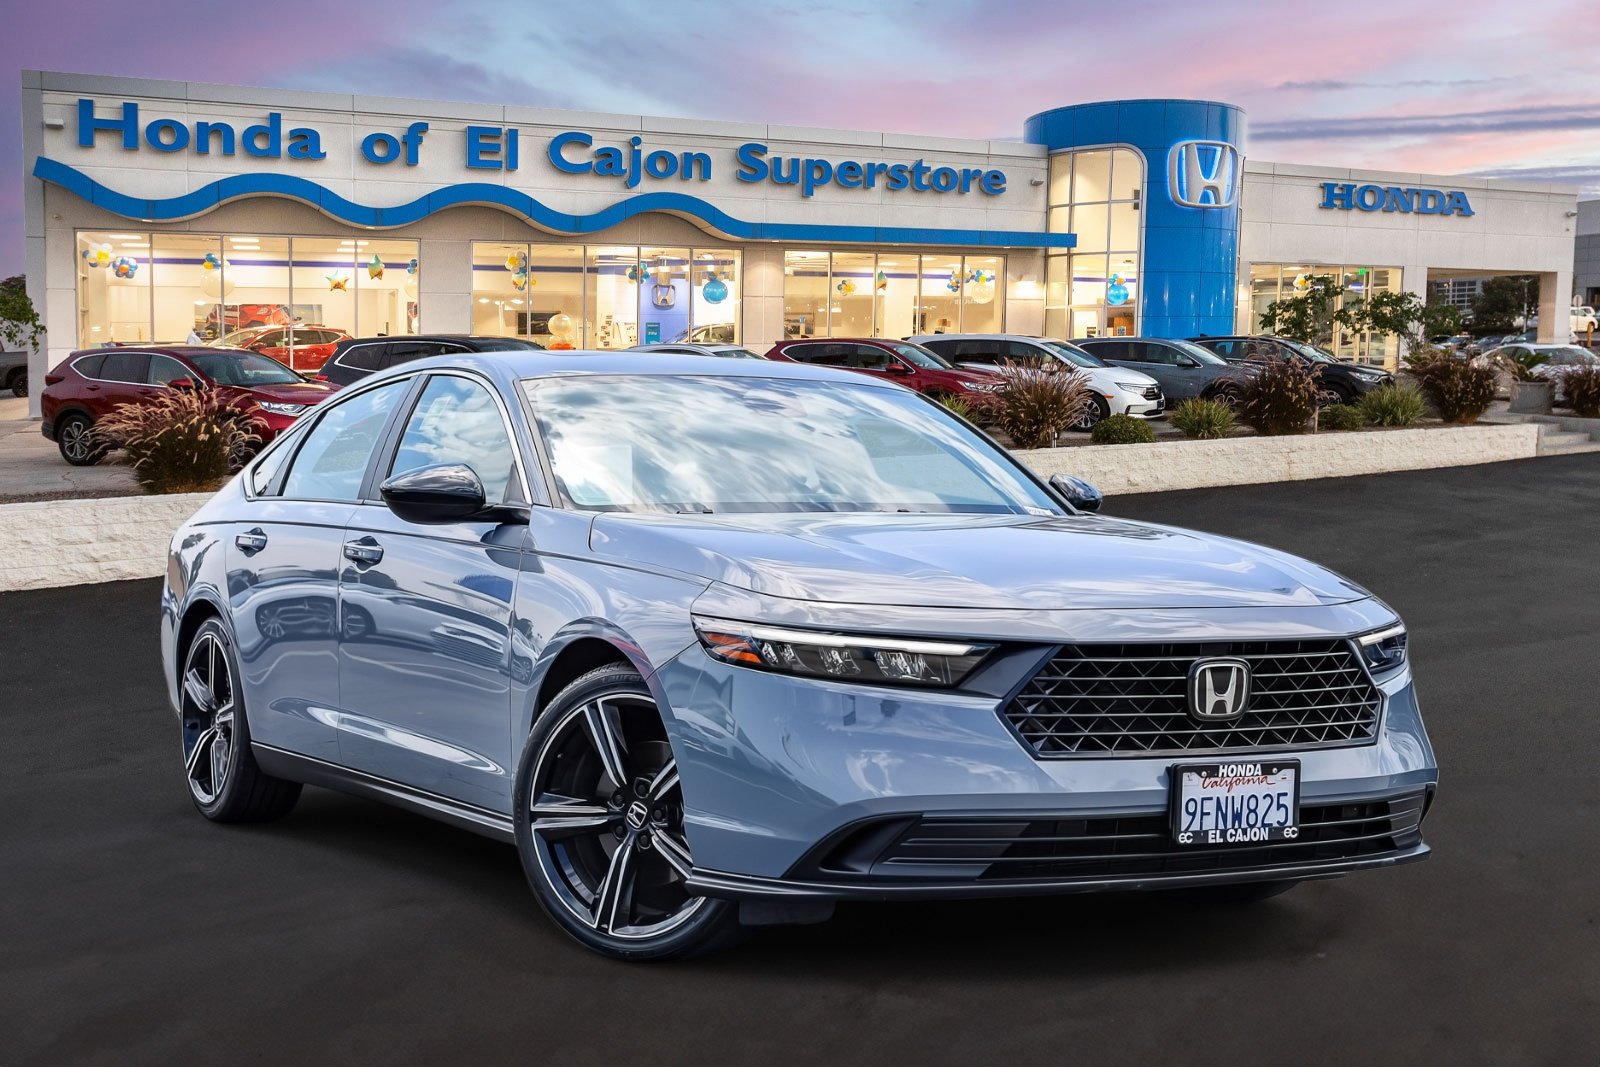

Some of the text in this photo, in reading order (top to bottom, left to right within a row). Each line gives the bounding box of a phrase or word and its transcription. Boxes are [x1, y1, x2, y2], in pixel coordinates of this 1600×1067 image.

[78, 98, 1007, 198] Honda of El Cajon Superstore
[1319, 182, 1475, 217] HONDA
[1218, 763, 1262, 778] HONDA
[1202, 775, 1276, 793] California
[1184, 792, 1289, 832] 9FNW825
[1207, 827, 1269, 844] EL CAJON
